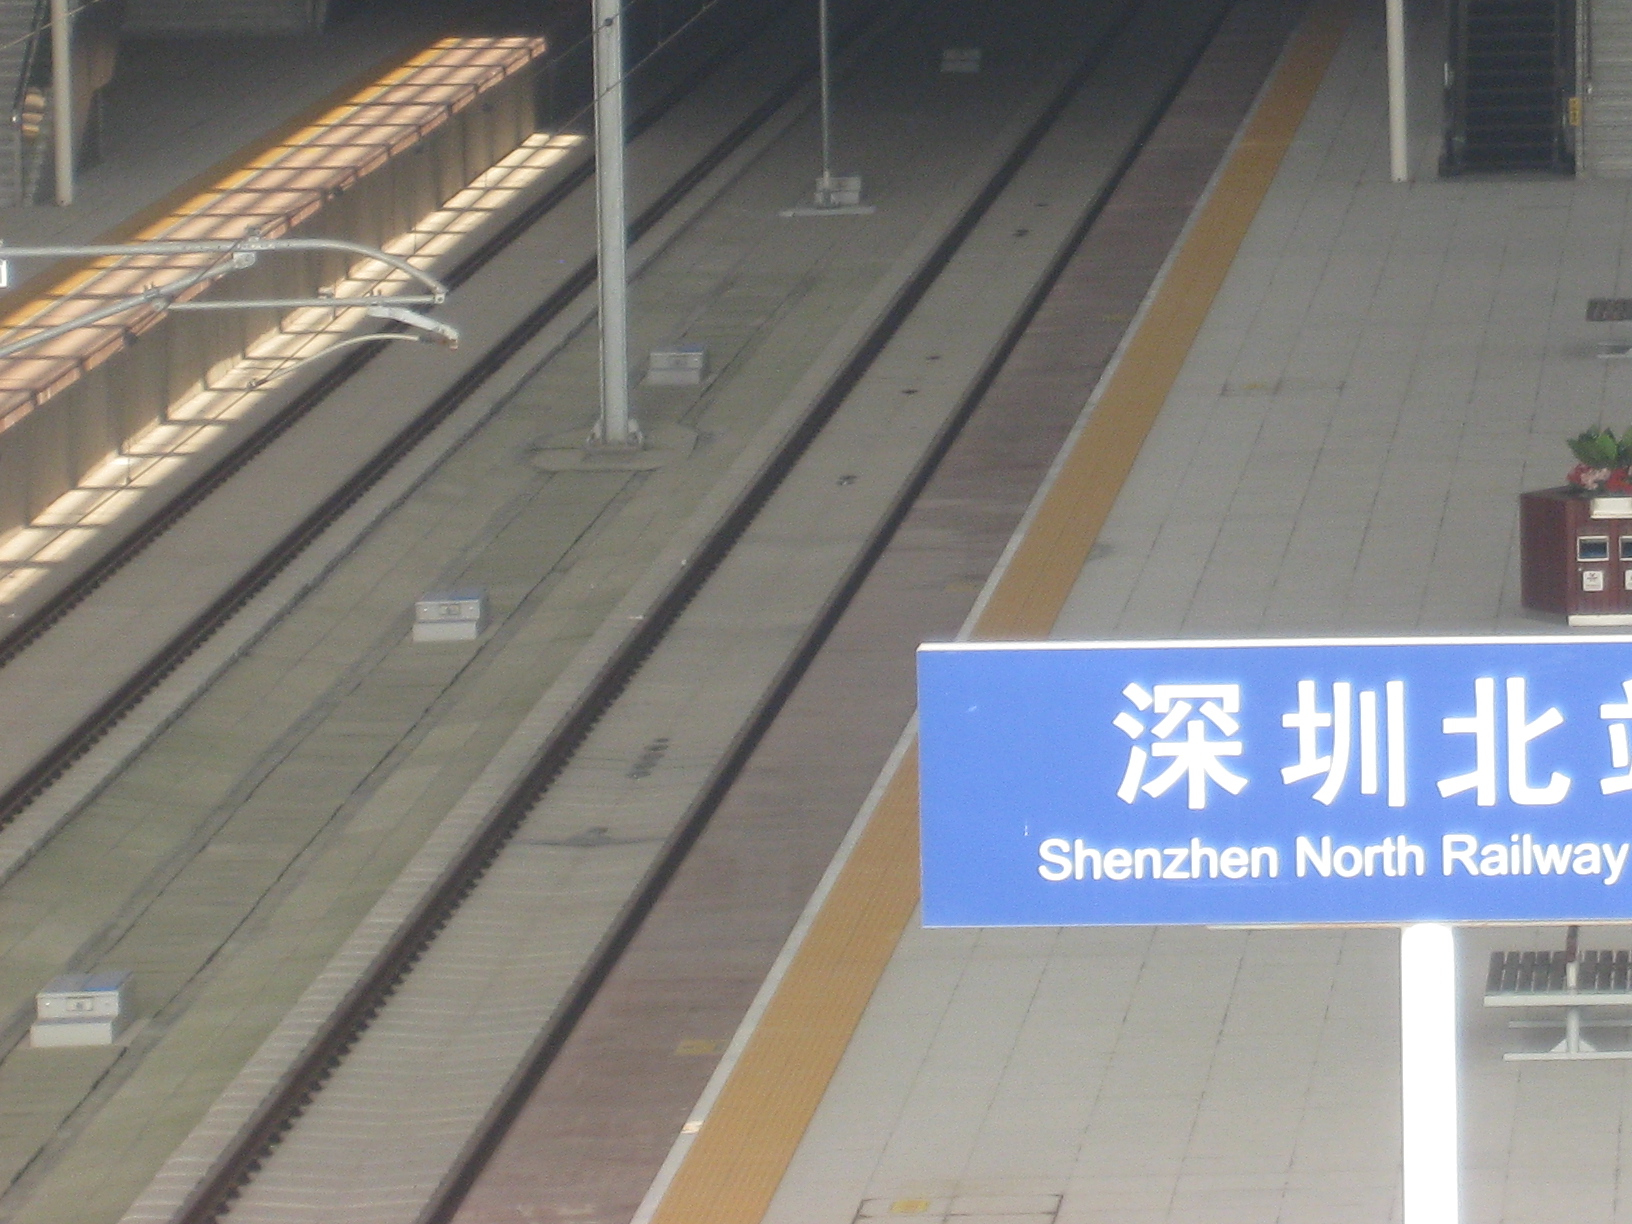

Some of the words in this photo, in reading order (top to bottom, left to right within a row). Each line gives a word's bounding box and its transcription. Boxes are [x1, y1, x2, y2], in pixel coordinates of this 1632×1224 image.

[1039, 838, 1278, 880] Shenzhen
[1297, 835, 1424, 877] North
[1443, 834, 1629, 885] Railway
